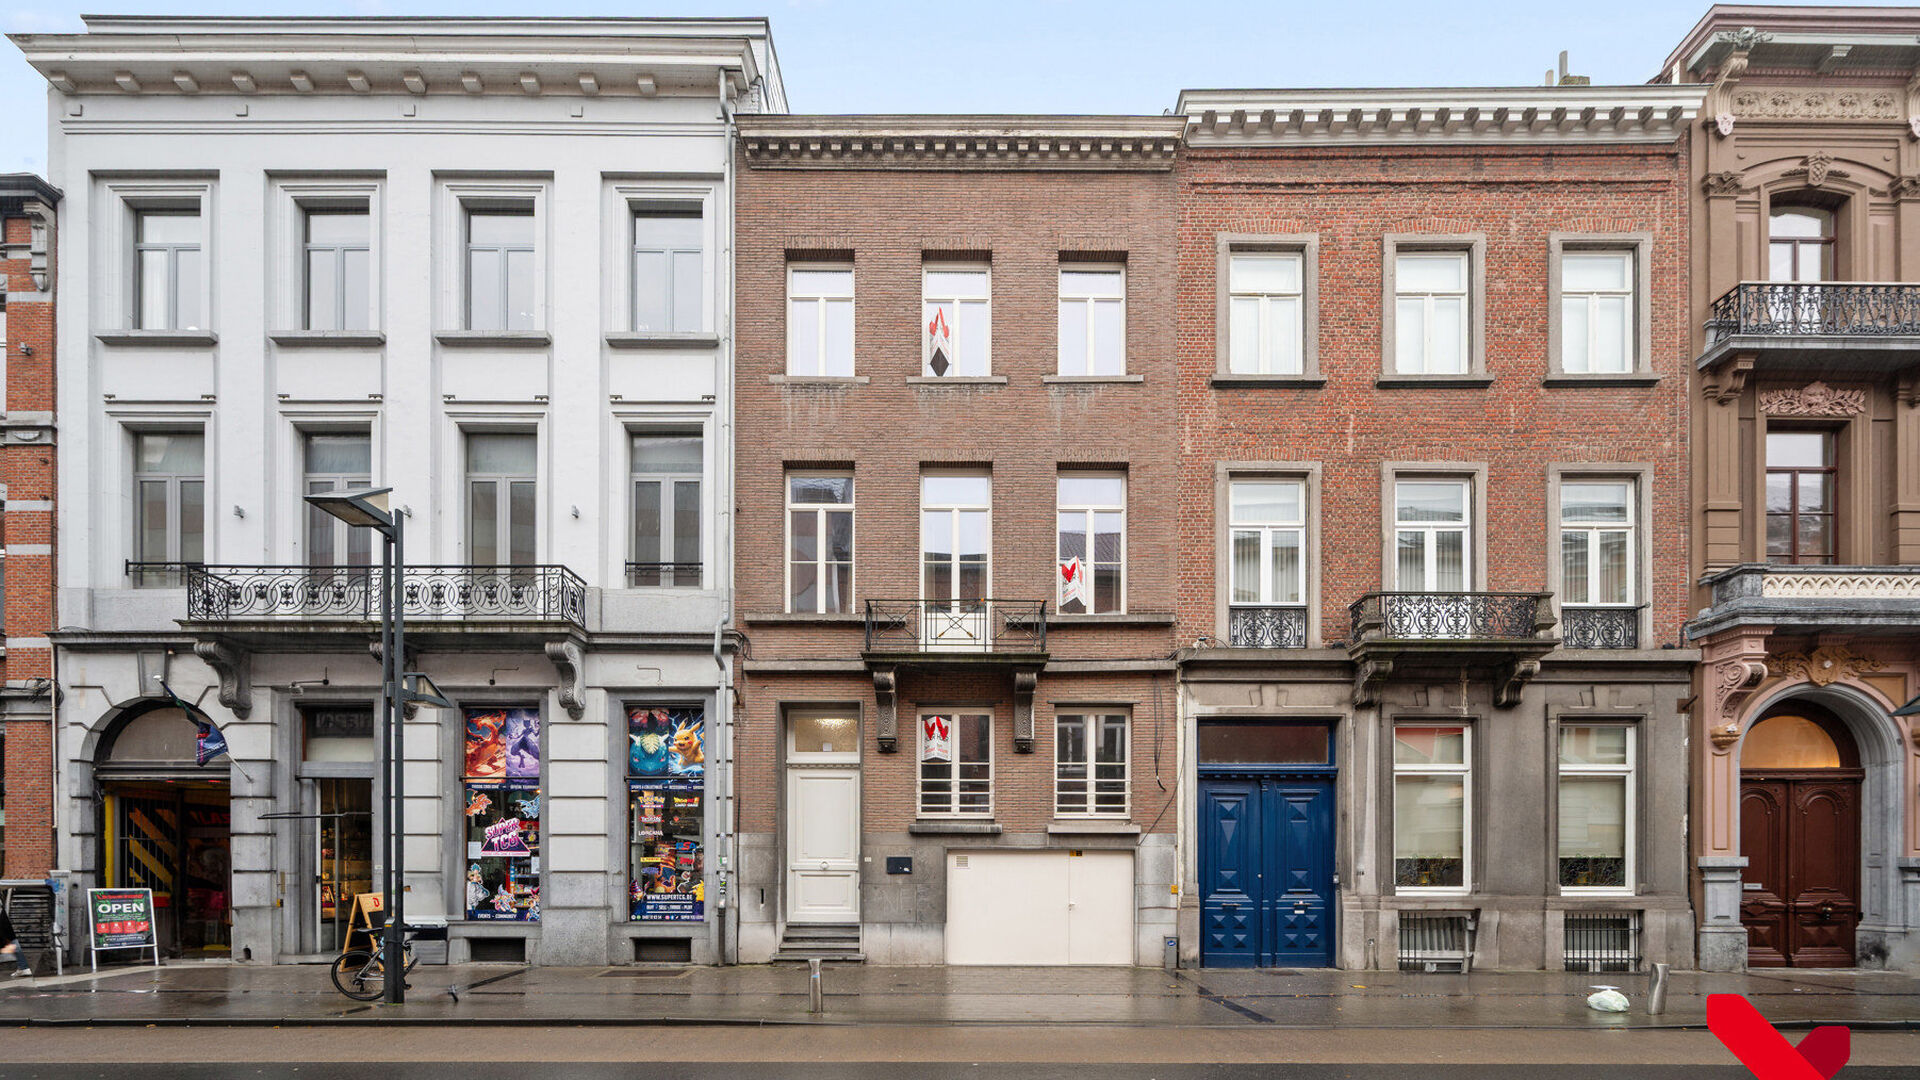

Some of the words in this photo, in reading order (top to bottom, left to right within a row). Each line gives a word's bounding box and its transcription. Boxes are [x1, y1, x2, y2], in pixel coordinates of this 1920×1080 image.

[485, 818, 520, 839] SUPER
[491, 831, 519, 851] TCG
[98, 903, 144, 914] OPEN
